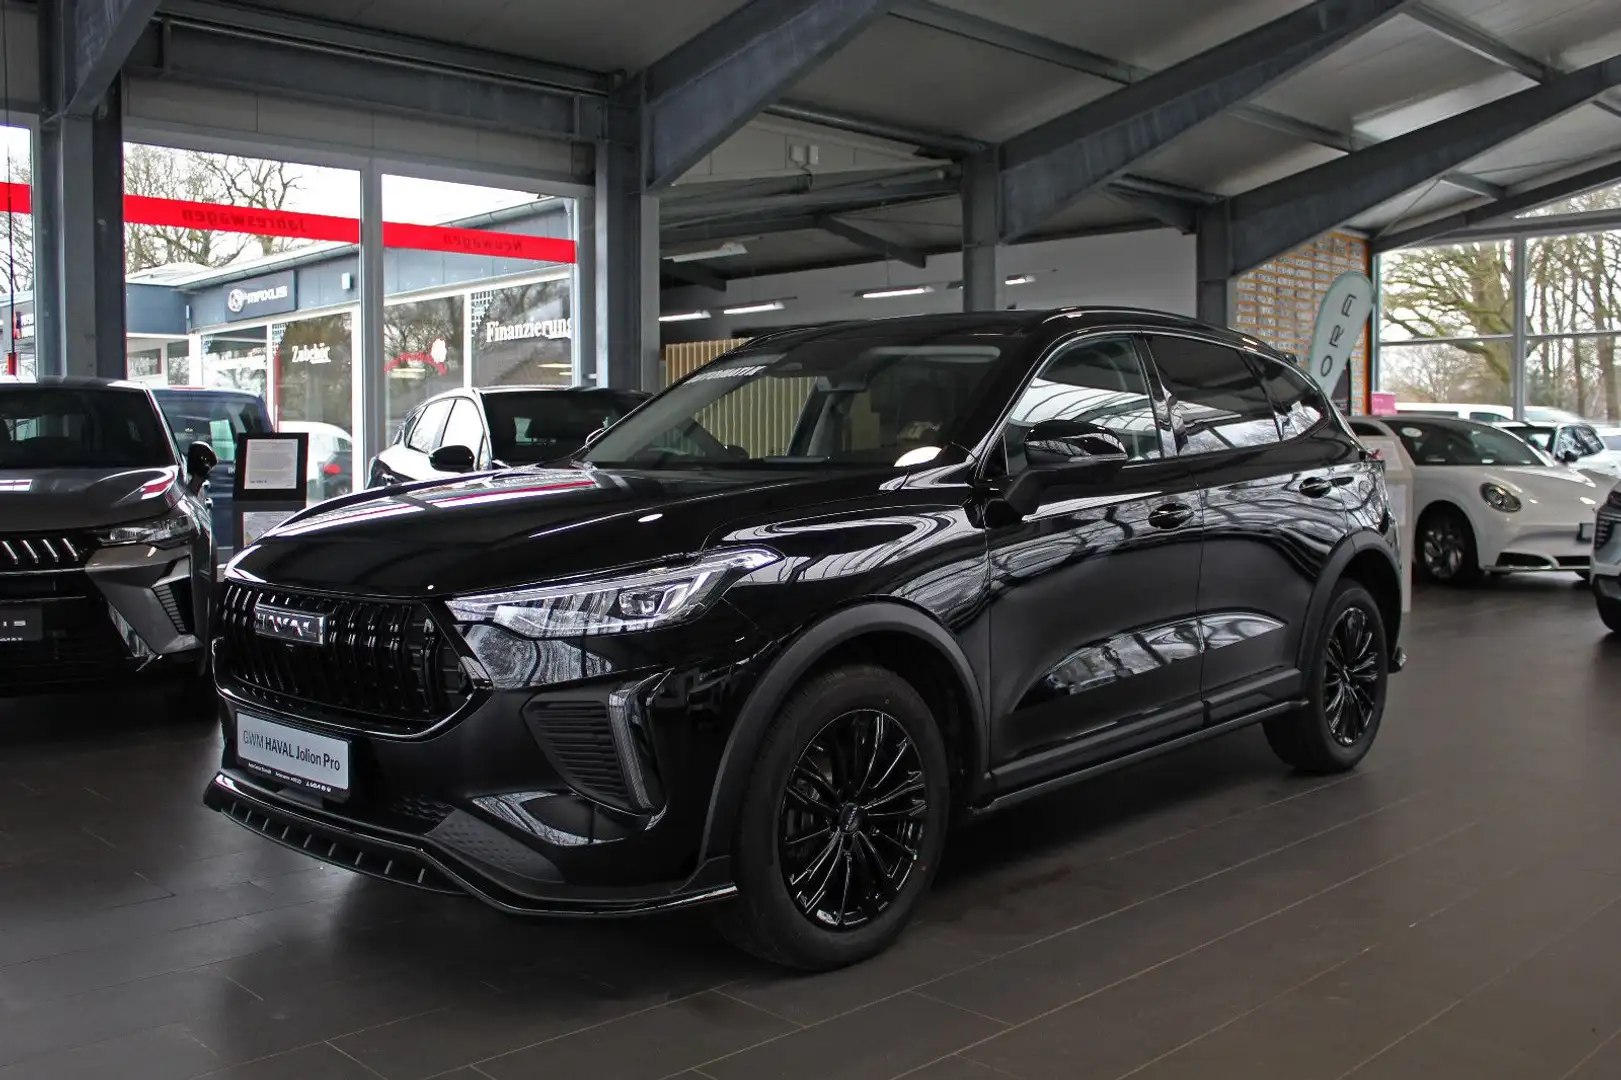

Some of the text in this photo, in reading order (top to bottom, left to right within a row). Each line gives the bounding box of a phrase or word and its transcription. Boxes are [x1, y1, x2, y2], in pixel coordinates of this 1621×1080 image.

[243, 730, 341, 771] GWM HAVAL Jolion Pro
